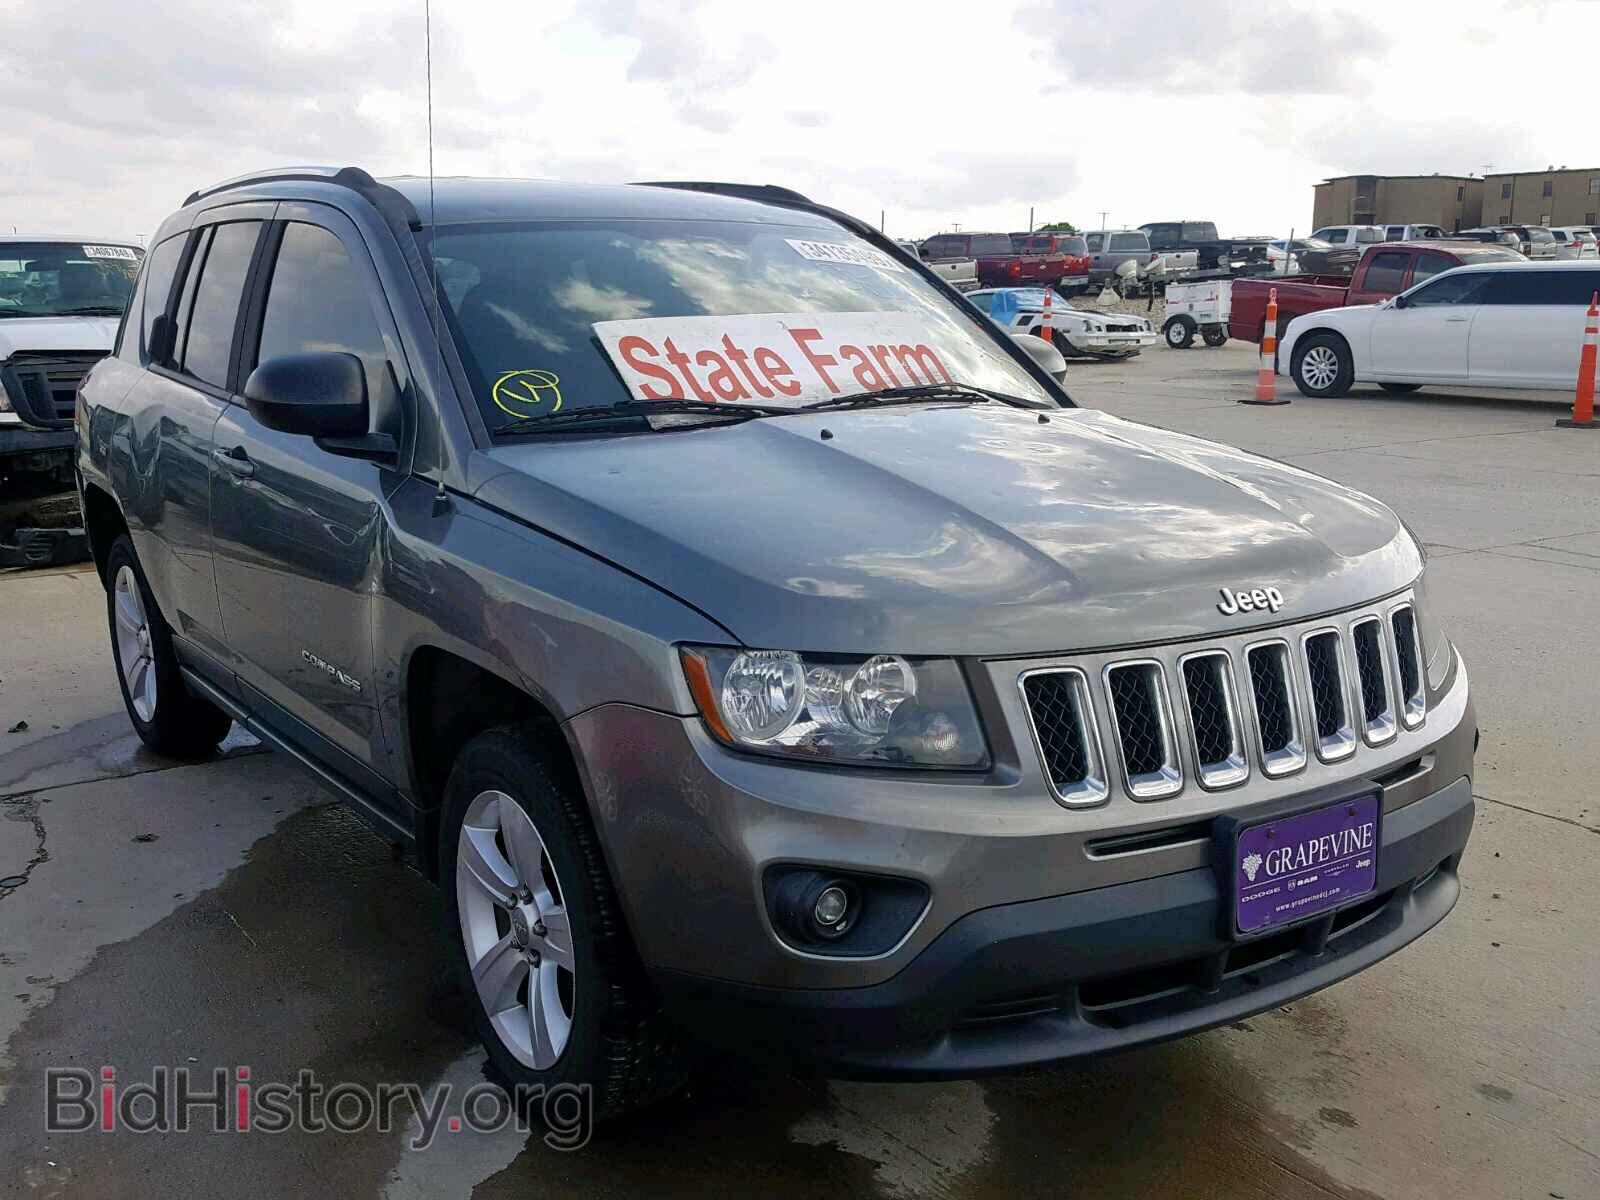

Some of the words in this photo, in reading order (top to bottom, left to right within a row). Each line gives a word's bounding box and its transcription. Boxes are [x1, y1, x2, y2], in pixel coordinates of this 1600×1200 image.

[617, 332, 802, 403] State
[788, 327, 952, 394] Farm
[1217, 587, 1284, 616] Jeep
[1265, 822, 1373, 877] GRAPEVINE
[1241, 886, 1281, 903] DODGE
[1296, 875, 1319, 887] RAM
[1355, 858, 1371, 869] Jeep
